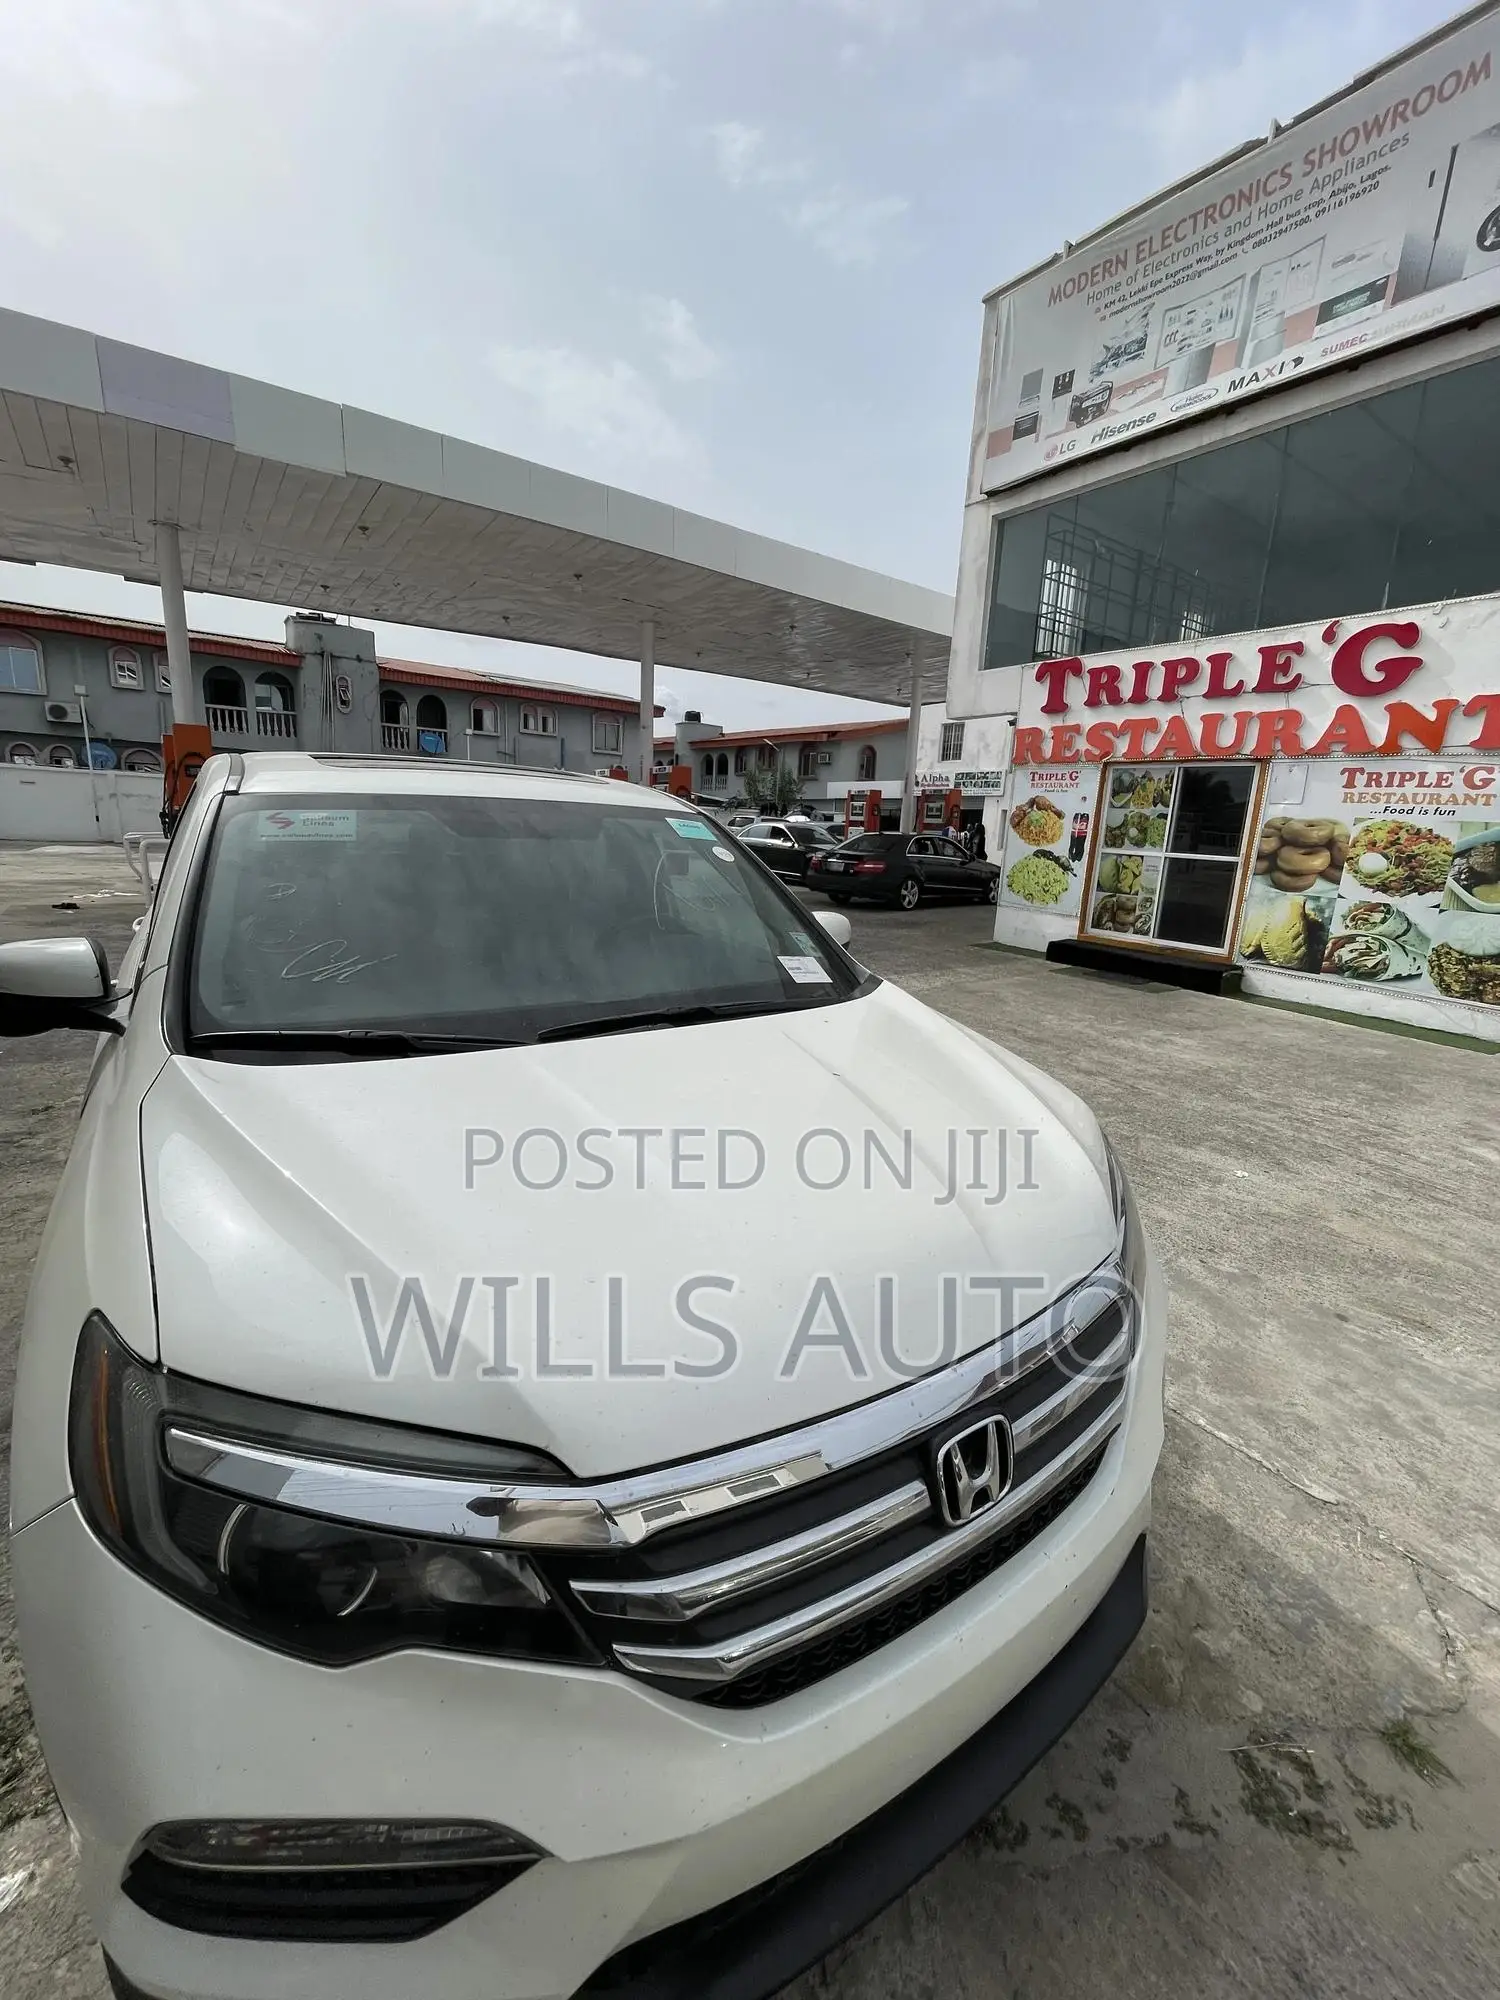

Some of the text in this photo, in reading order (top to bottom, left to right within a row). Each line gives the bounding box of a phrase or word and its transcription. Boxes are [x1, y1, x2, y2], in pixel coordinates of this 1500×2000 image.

[1047, 50, 1492, 307] MODERN ELECTRONICS SHOWROOM
[1086, 131, 1410, 306] Home of Electronics and Home Appliances
[1104, 300, 1116, 310] KM
[1129, 283, 1148, 298] Lekki
[1150, 277, 1163, 288] Epe
[1165, 262, 1194, 281] Express
[1215, 246, 1226, 257] by
[1227, 228, 1264, 251] Kingdom
[1265, 215, 1284, 232] Hall
[1285, 208, 1301, 222] bus
[1108, 252, 1238, 319] modernshowroom2022@gmail.com
[1315, 180, 1380, 218] 09116196920
[1320, 332, 1369, 358] SUMEC
[1227, 359, 1286, 394] MAXI
[1090, 411, 1157, 444] Hisense
[1059, 439, 1077, 455] LG
[1035, 641, 1305, 714] TRIPLE
[920, 773, 951, 783] Alpha
[1340, 766, 1455, 790] TRIPLE
[1341, 791, 1497, 807] RESTAURANT
[1418, 806, 1429, 817] is
[1433, 806, 1457, 817] fun
